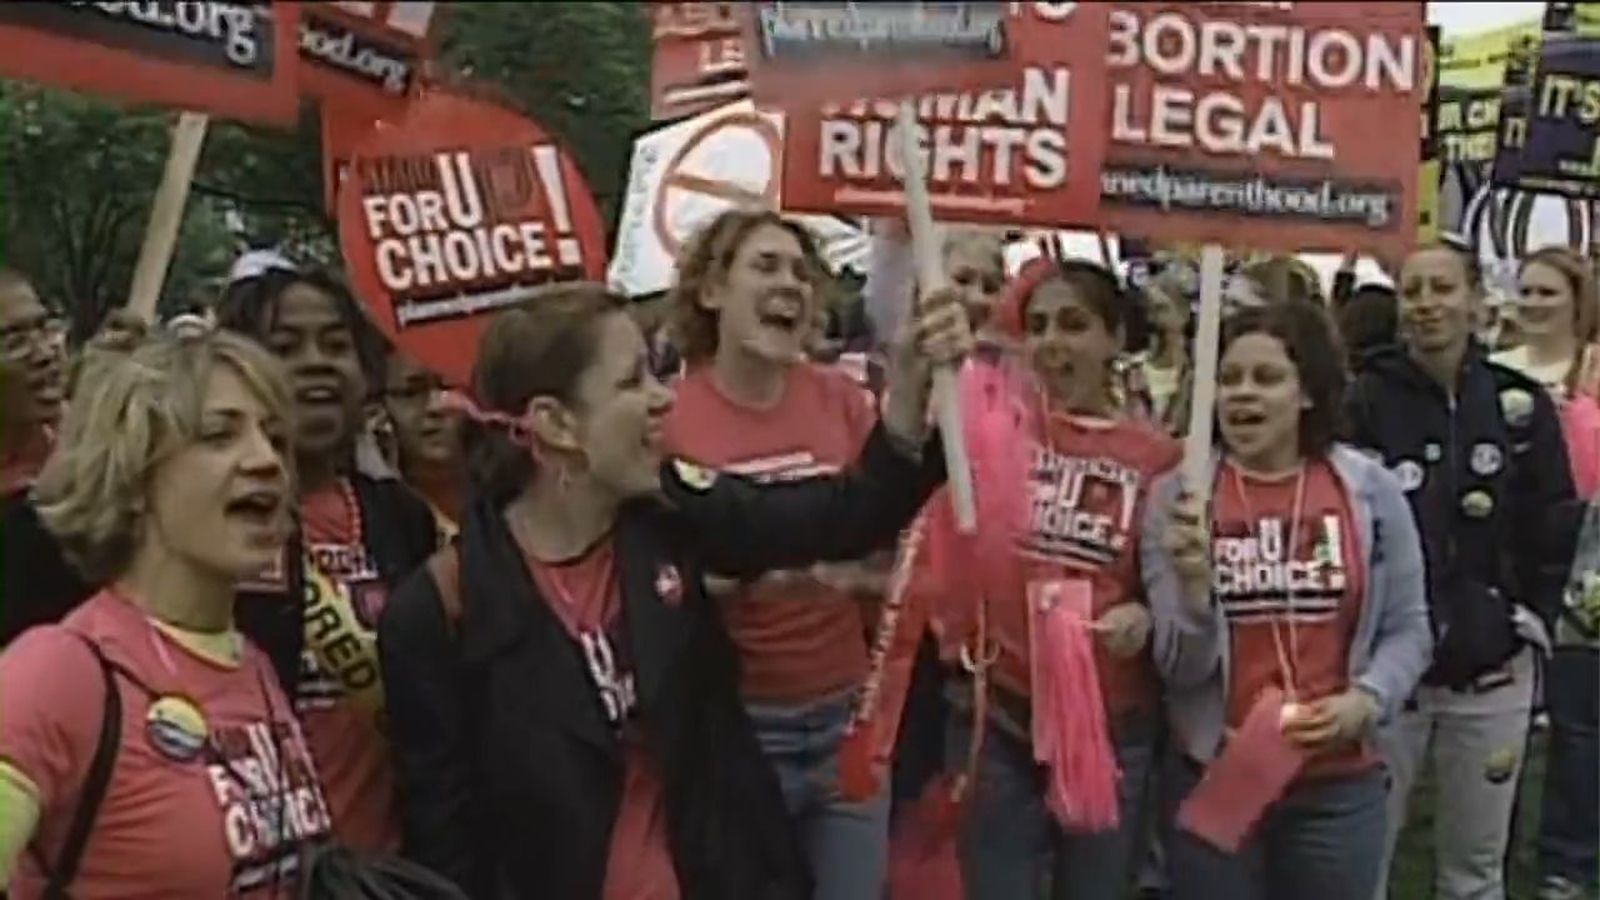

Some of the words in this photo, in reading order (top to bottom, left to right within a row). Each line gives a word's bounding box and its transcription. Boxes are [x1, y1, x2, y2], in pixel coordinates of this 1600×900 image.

[1105, 10, 1416, 92] BORTION
[820, 119, 1067, 189] RIGHTS
[1112, 84, 1335, 161] LEGAL
[362, 190, 449, 240] FOR
